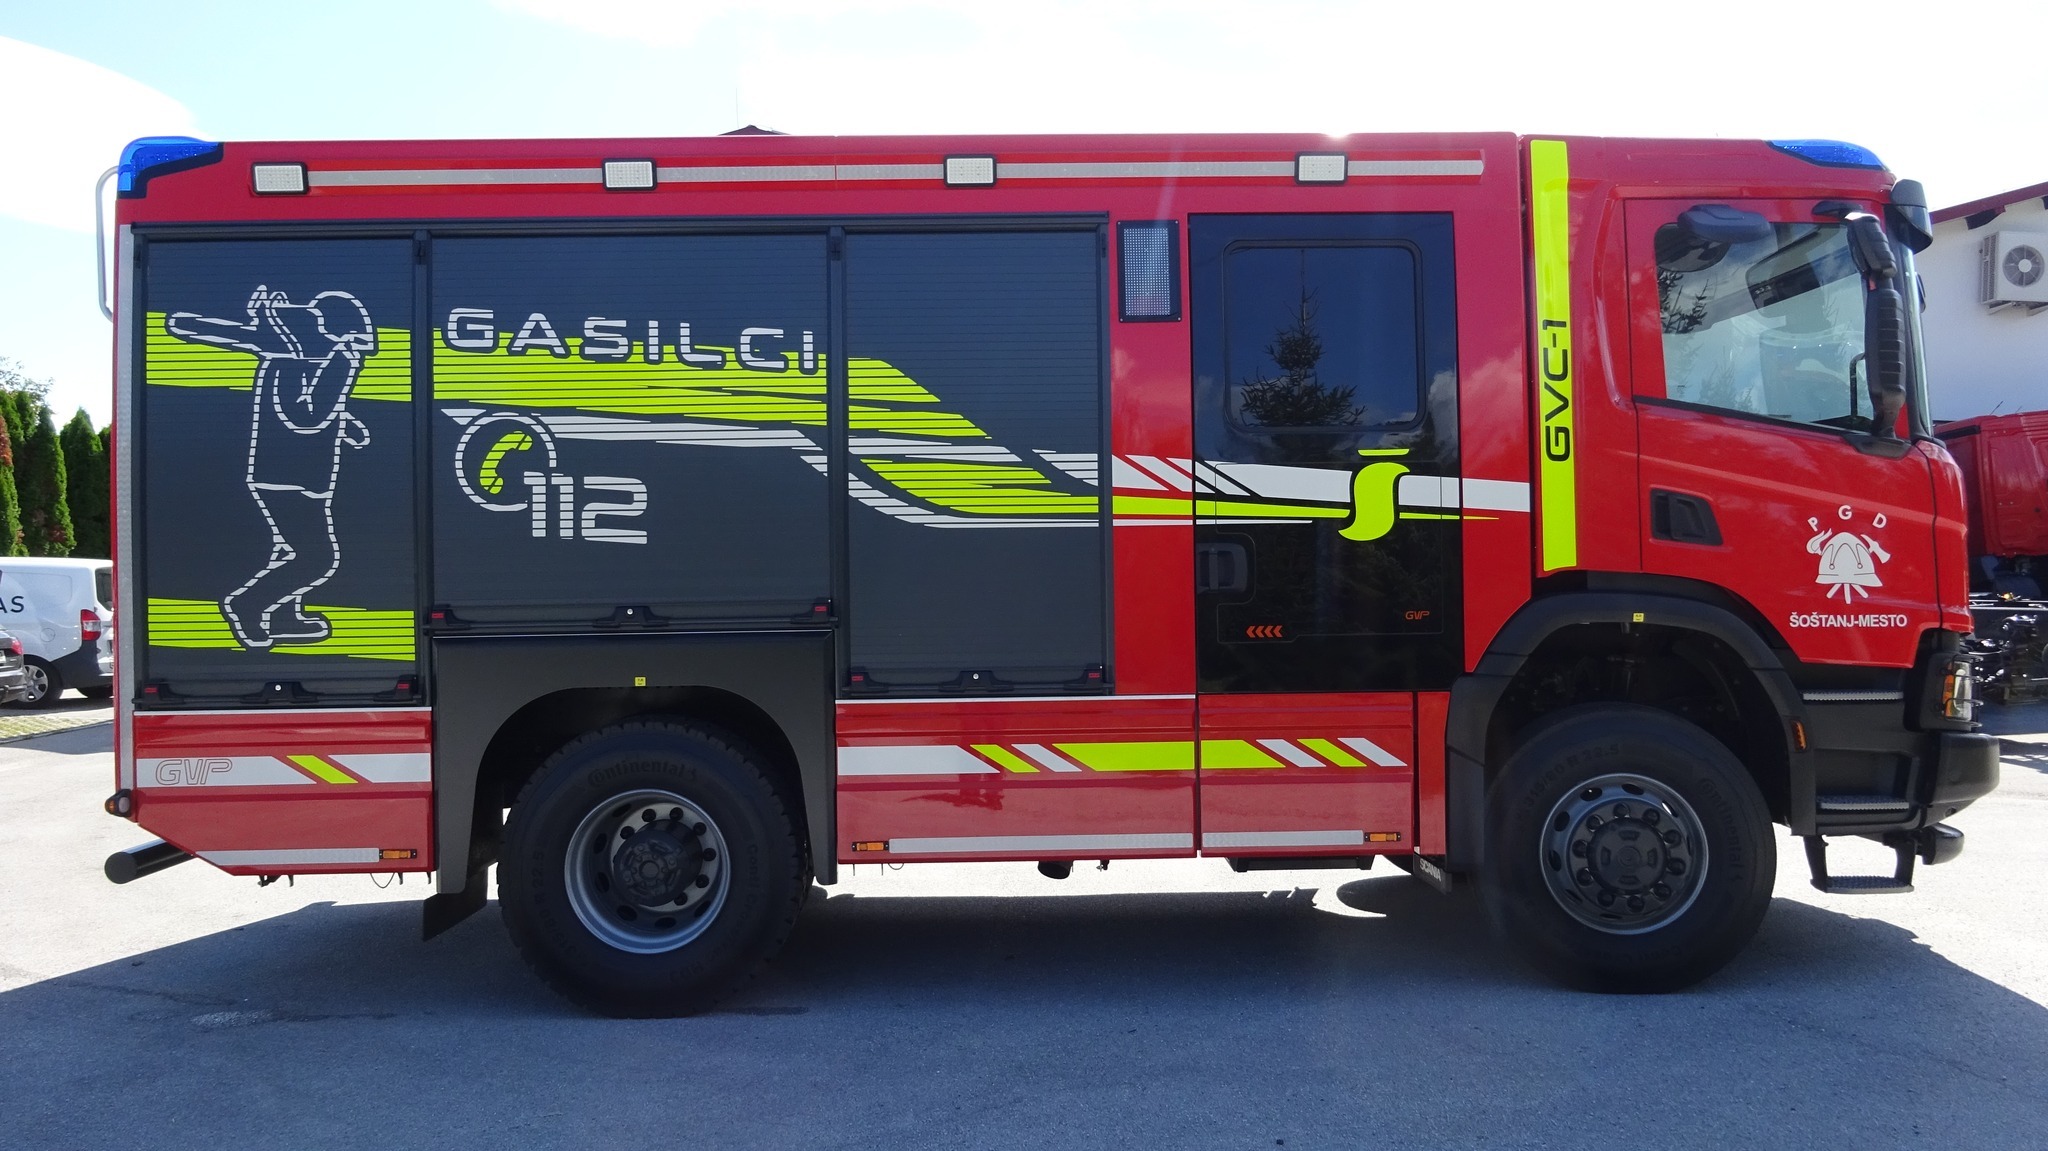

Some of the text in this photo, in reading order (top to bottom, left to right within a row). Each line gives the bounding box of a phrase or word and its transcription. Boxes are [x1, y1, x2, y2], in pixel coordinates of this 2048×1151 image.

[447, 307, 814, 370] GASILCI
[1542, 319, 1571, 462] GVC-1
[523, 471, 648, 545] 112
[1405, 610, 1430, 621] GVP
[1789, 611, 1908, 628] ŠOŠTANJ-MESTO
[155, 758, 233, 786] GVP
[588, 759, 686, 786] Continental
